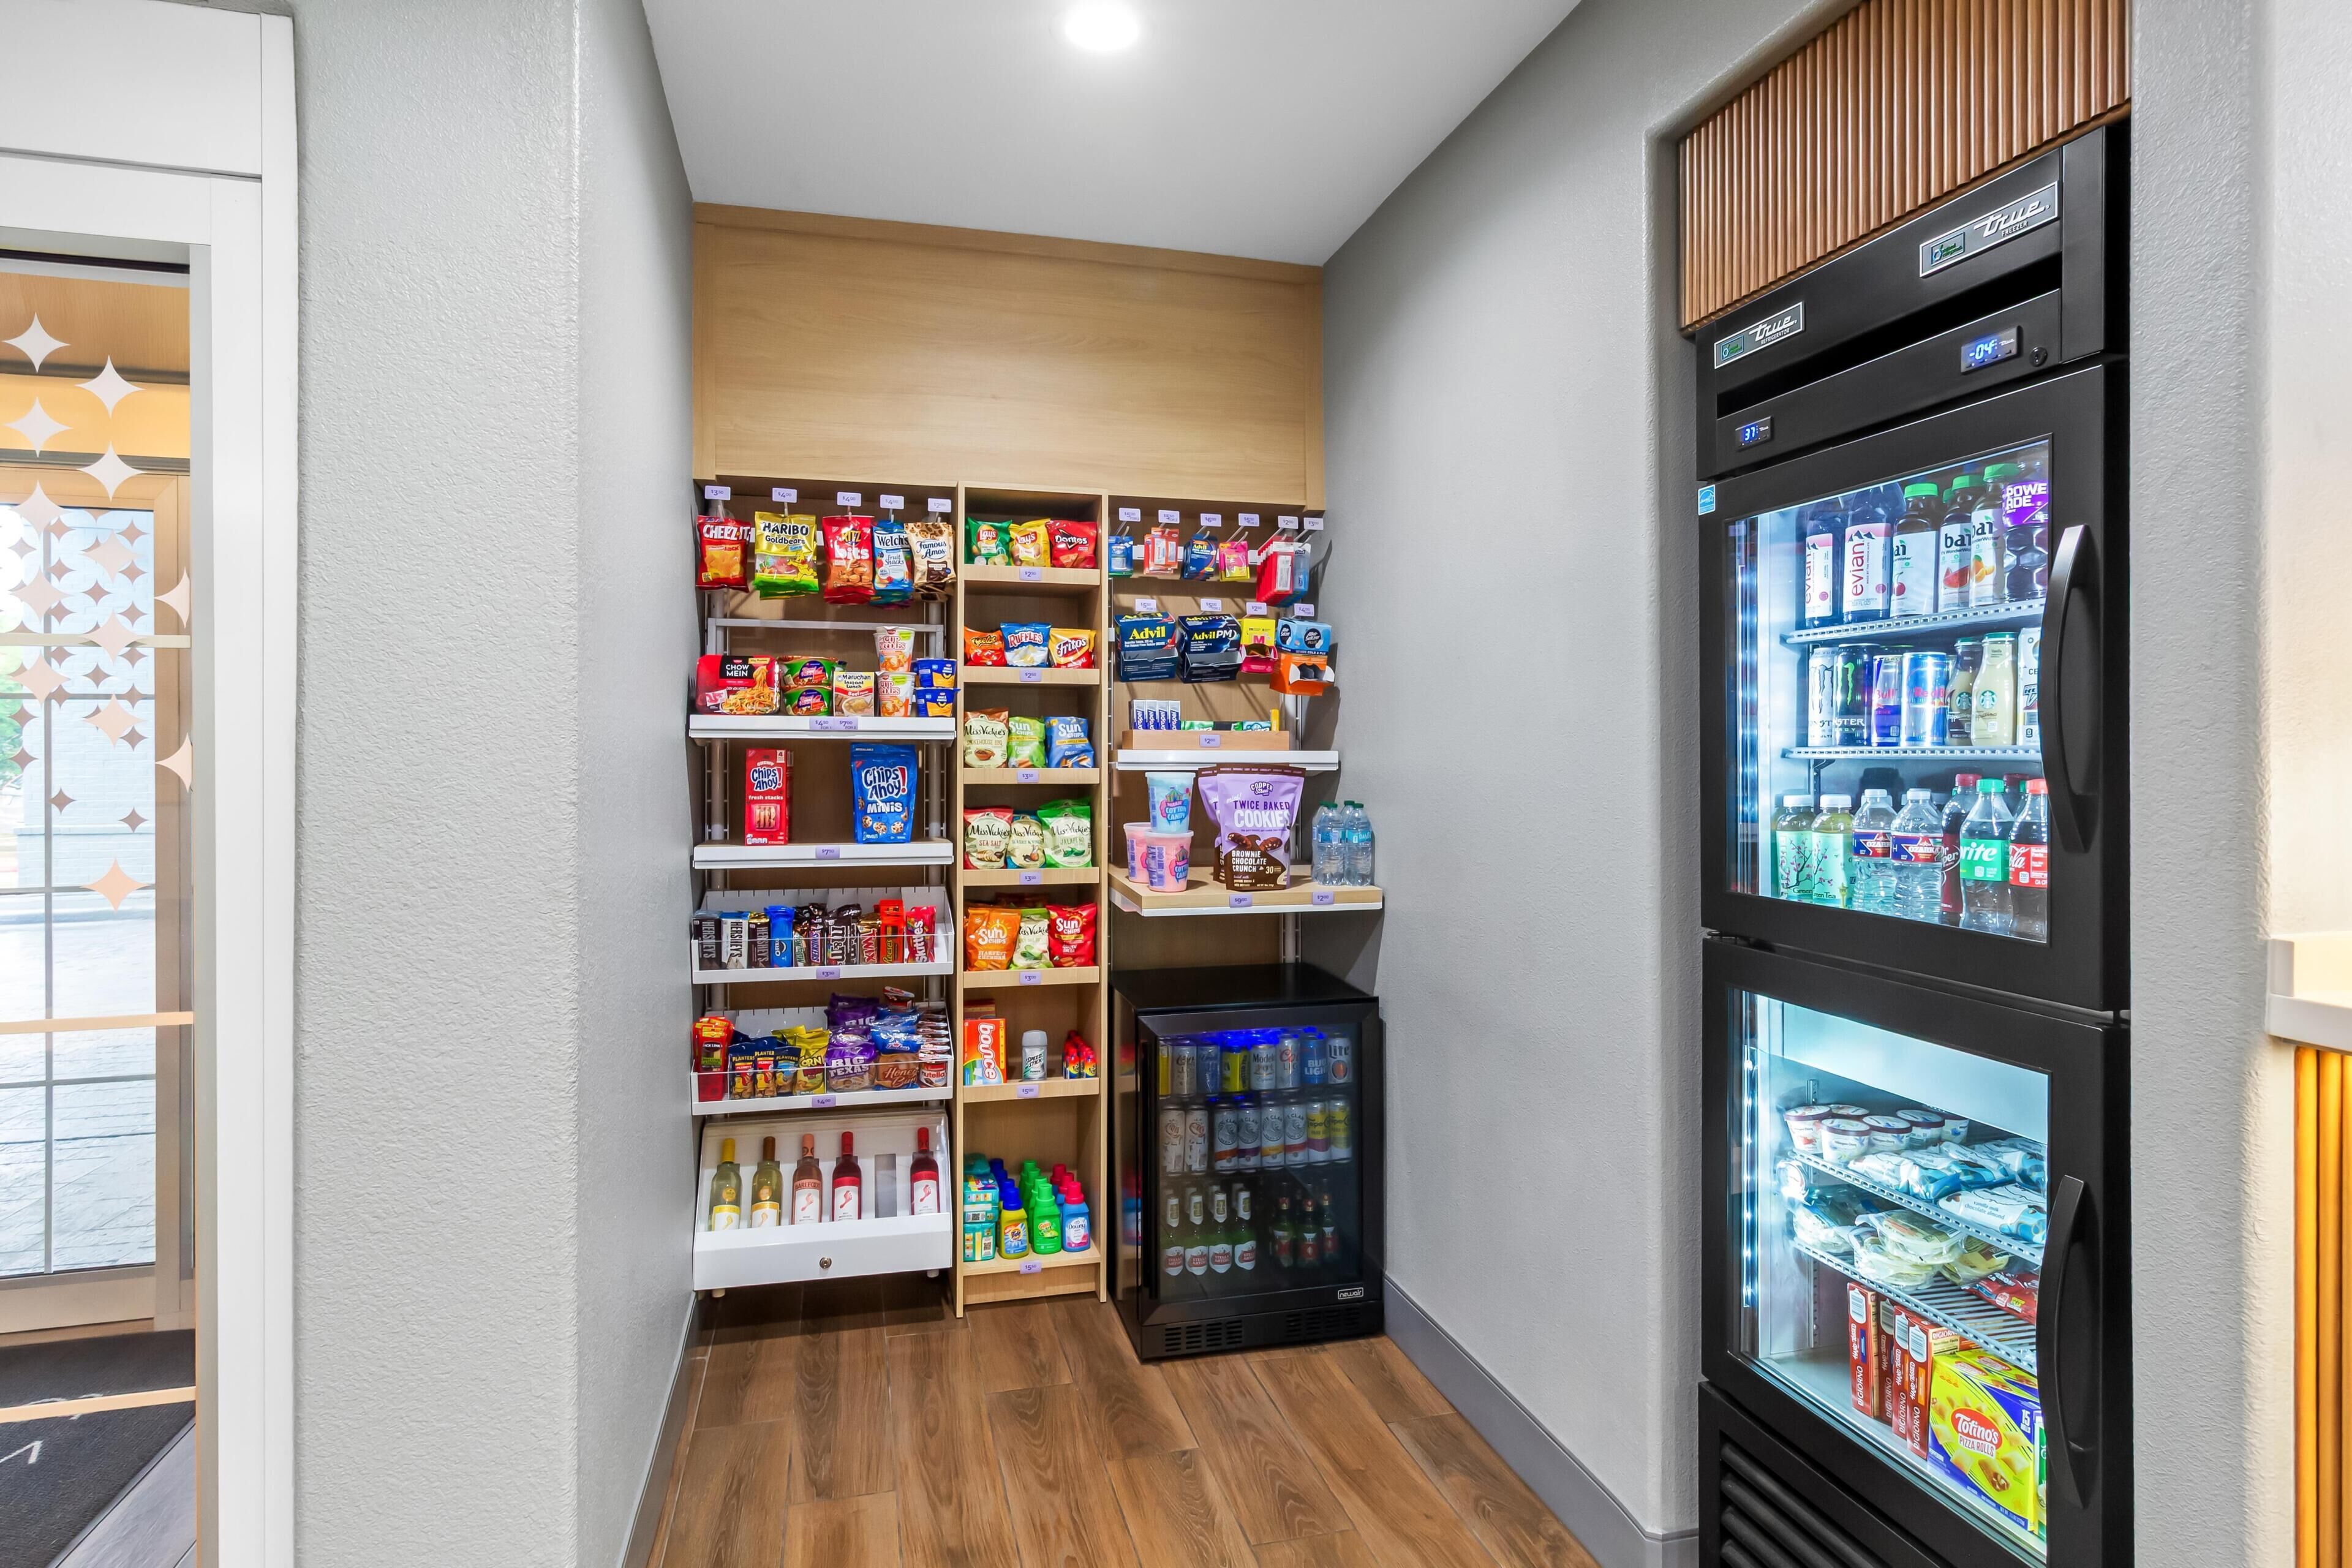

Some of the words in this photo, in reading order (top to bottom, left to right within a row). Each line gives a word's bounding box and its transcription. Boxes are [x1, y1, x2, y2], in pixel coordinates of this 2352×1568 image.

[2001, 221, 2028, 238] FREEZER
[1760, 328, 1790, 345] REFRIGERATOR
[2006, 483, 2047, 497] POWE
[761, 521, 809, 536] HARIBO
[979, 530, 997, 540] Lay's
[765, 535, 806, 545] Goldbears
[876, 535, 909, 547] Welch's
[1017, 533, 1036, 544] Lay's
[1055, 535, 1088, 544] Doritos
[834, 545, 870, 560] bits
[916, 541, 946, 554] Famous
[921, 549, 945, 559] Amos
[1849, 541, 1864, 597] evian
[1008, 631, 1043, 647] RUFFLES
[1129, 626, 1166, 640] Advil
[1191, 632, 1216, 641] Advil
[1216, 630, 1232, 639] PM
[1056, 636, 1087, 657] Fritos
[964, 725, 981, 735] Miss
[980, 725, 1006, 739] Vickie's
[1058, 723, 1082, 737] Sun
[751, 766, 777, 781] Chips
[755, 767, 783, 791] Ahoy!
[863, 766, 899, 785] Chips
[868, 766, 907, 800] Ahoy!
[1251, 782, 1273, 791] COOPER
[1234, 800, 1259, 810] TWICE
[1263, 801, 1290, 810] BAKED
[1234, 810, 1291, 828] COOKIES
[970, 825, 987, 836] Miss
[985, 823, 1010, 840] Vickie's
[1056, 918, 1079, 932] Sun
[978, 929, 1005, 945] Sun
[861, 928, 878, 963] TWIX
[845, 1016, 876, 1026] BIG
[978, 1022, 997, 1080] bounce
[1328, 1044, 1349, 1058] Lite
[799, 1056, 823, 1068] CORN
[831, 1057, 865, 1069] BIG
[1026, 1054, 1042, 1063] SPEED
[1028, 1059, 1042, 1068] STICK
[829, 1065, 870, 1077] TEXAS
[884, 1067, 918, 1079] Honey
[1340, 1289, 1362, 1298] newair
[1932, 1329, 1959, 1340] DIGIORN
[2021, 1409, 2030, 1423] 15
[1954, 1412, 1999, 1445] Totino's
[1959, 1435, 1977, 1451] PIZZA
[1979, 1442, 1994, 1458] ROLLS
